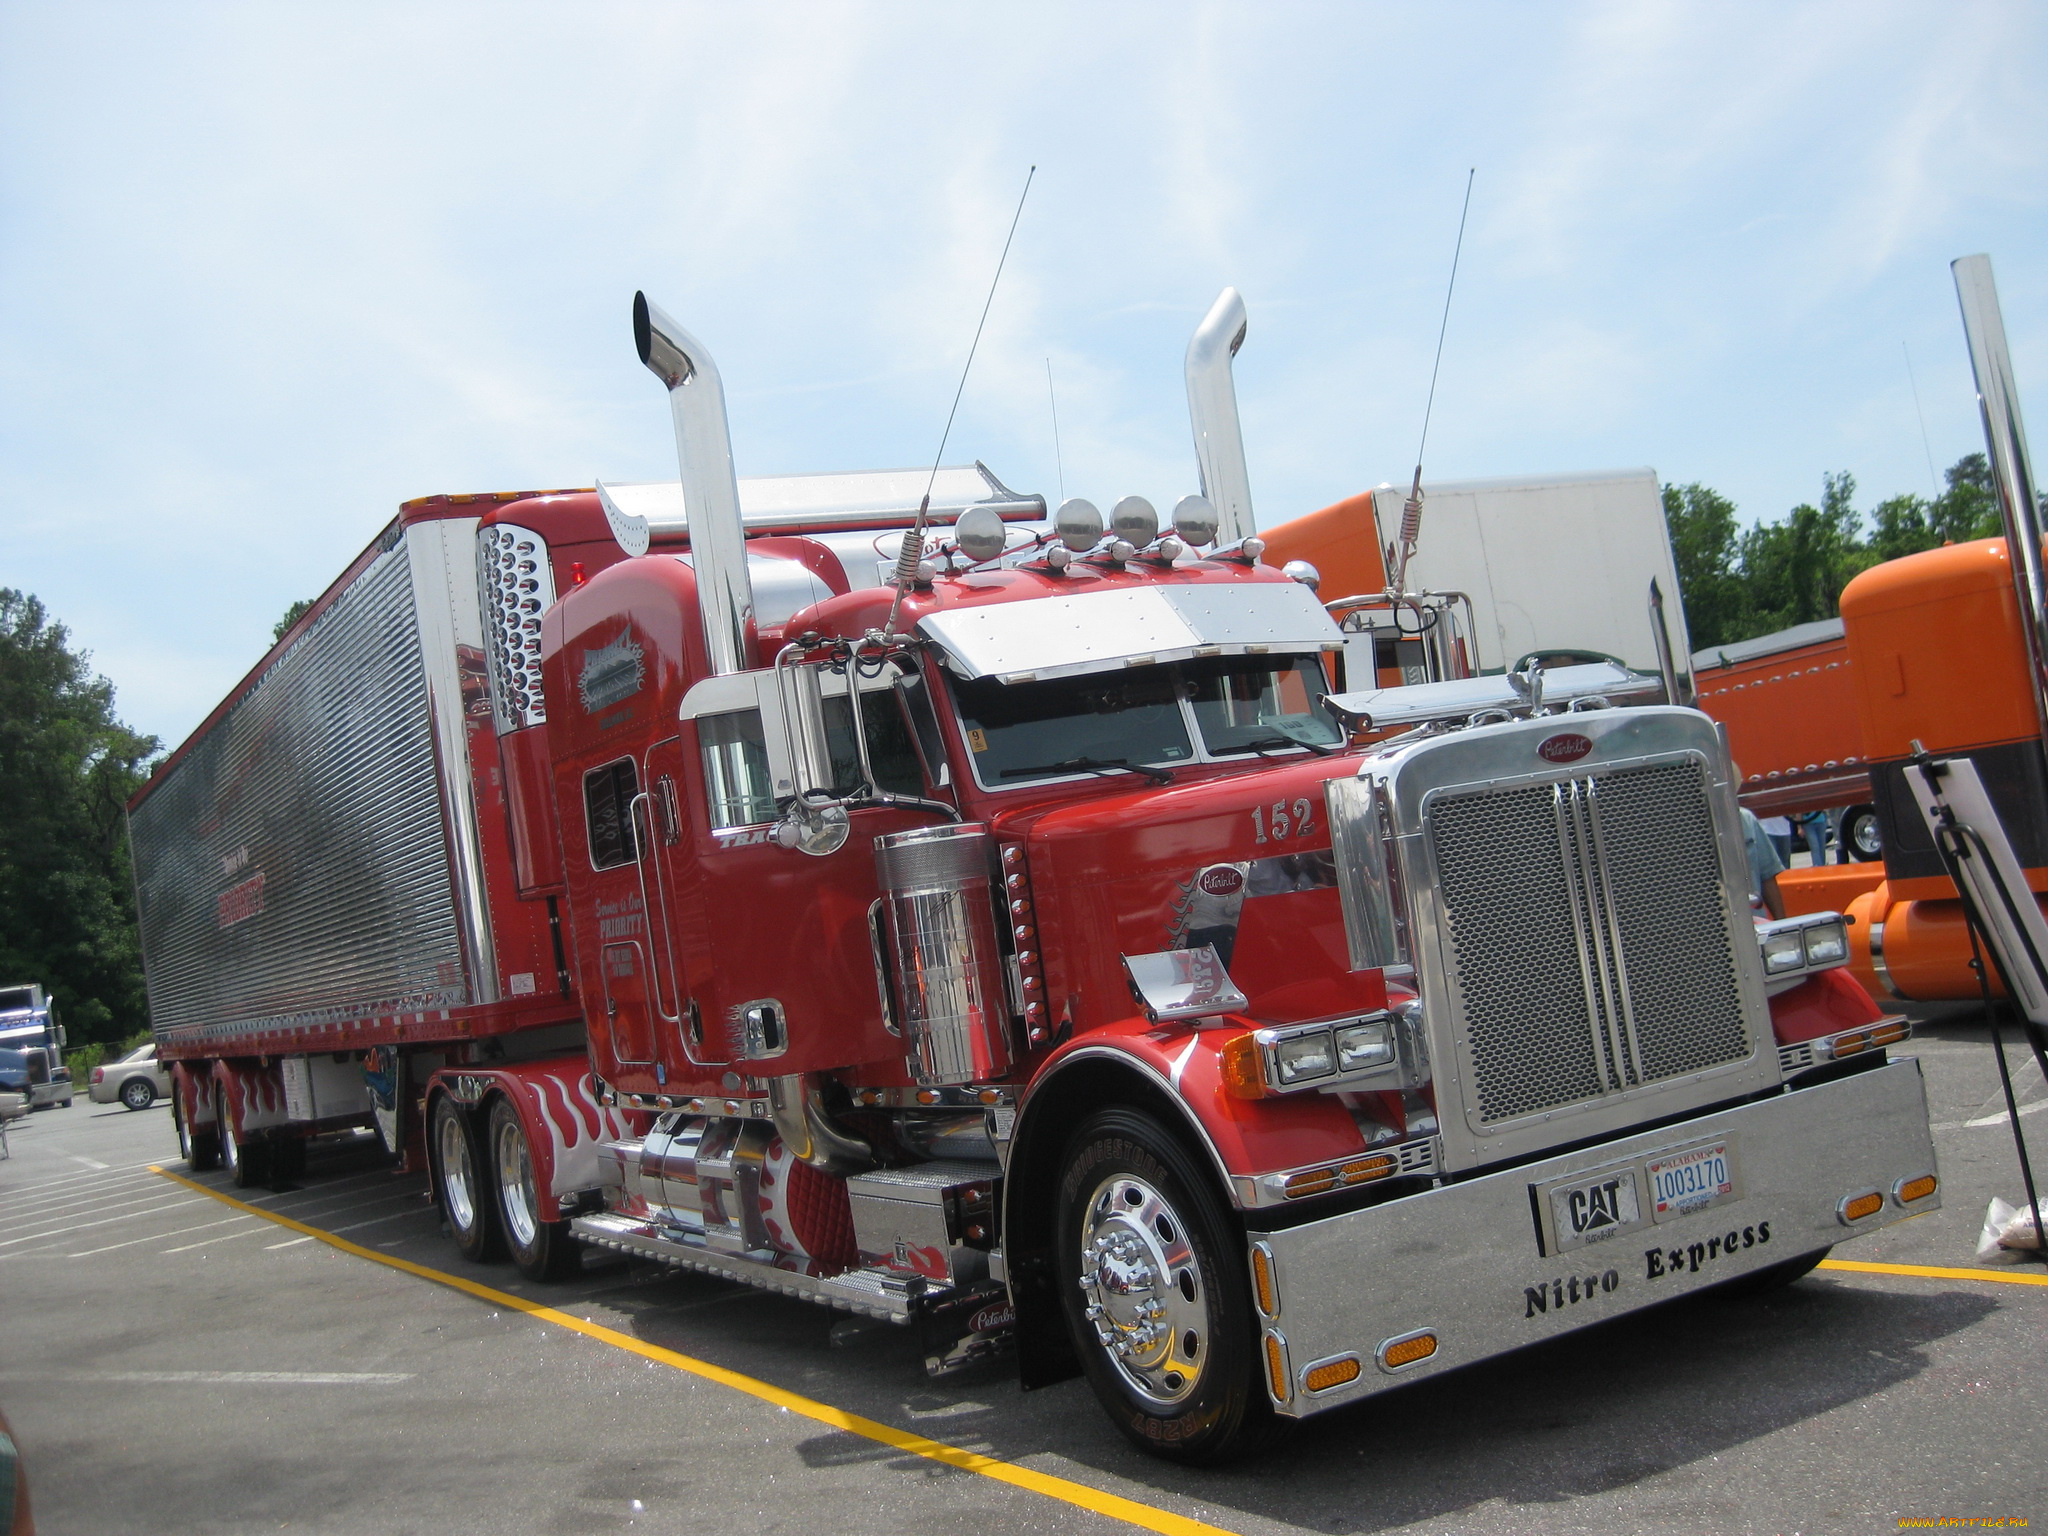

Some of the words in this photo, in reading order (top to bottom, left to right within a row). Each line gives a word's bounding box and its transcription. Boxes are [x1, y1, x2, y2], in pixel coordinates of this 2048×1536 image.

[972, 731, 980, 740] 9
[1544, 738, 1588, 758] Peterbilt
[1251, 798, 1315, 844] 152
[1204, 871, 1238, 890] Peterbilt
[600, 913, 643, 939] PRIORITY
[1064, 1138, 1168, 1203] BRIDGESTONE
[1666, 1150, 1710, 1169] ALABAMA
[1655, 1158, 1725, 1202] 1003170
[1568, 1180, 1620, 1232] CAT
[1585, 1227, 1617, 1244] Peterbilt
[1524, 1269, 1619, 1318] Nitro
[1645, 1221, 1771, 1280] Express
